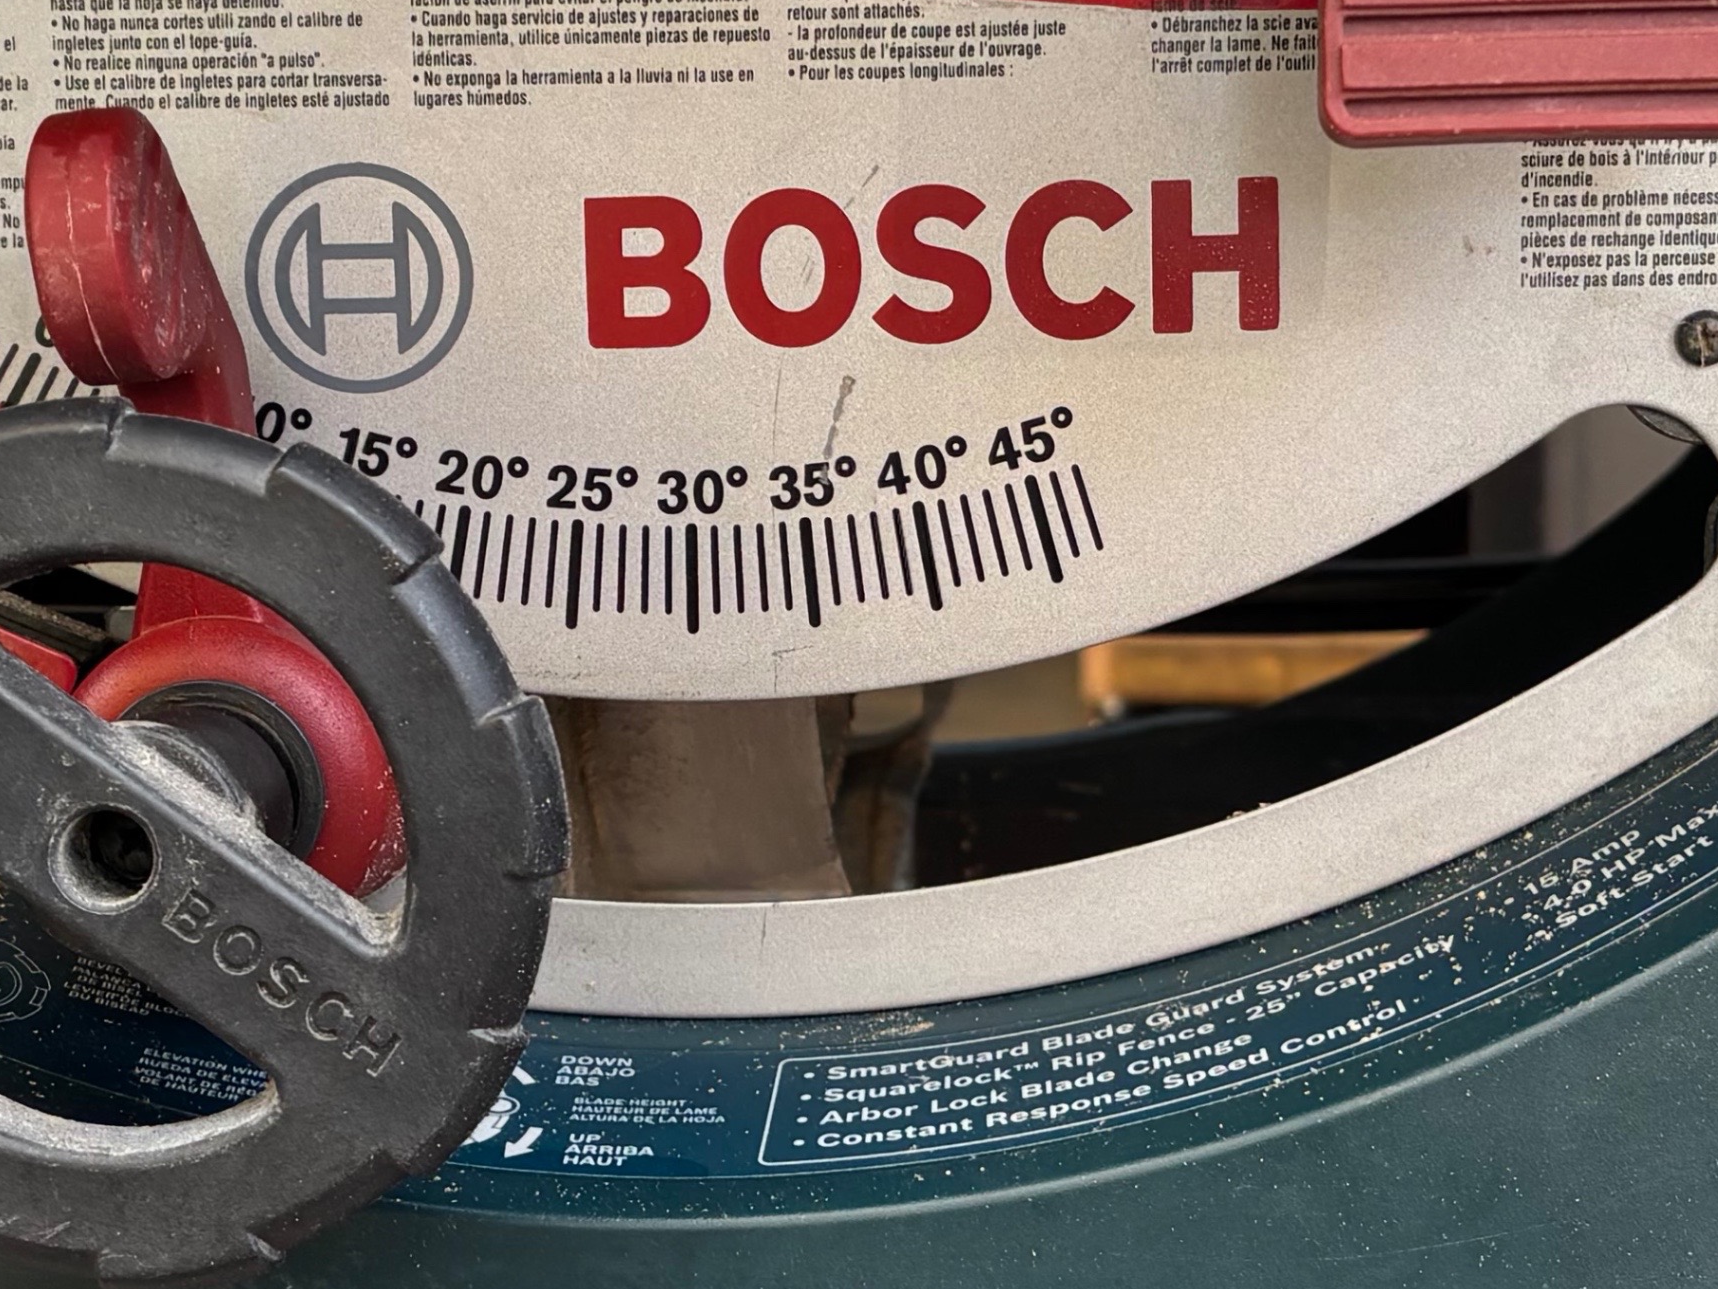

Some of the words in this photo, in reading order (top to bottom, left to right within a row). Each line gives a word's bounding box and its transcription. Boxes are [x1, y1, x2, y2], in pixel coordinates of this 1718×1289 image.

[414, 91, 463, 109] lugares
[583, 176, 1281, 350] BOSCH
[1583, 272, 1607, 289] pas
[1612, 270, 1645, 287] dans
[1649, 269, 1673, 286] des
[254, 401, 312, 445] 0°
[339, 426, 418, 477] 15°
[435, 449, 529, 500] 20°
[546, 464, 638, 512] 25°
[657, 464, 748, 514] 30°
[769, 455, 856, 510] 35°
[877, 435, 967, 495] 40°
[988, 406, 1073, 471] 45°
[1570, 829, 1640, 877] Amp
[1600, 847, 1646, 880] HP
[1555, 887, 1626, 929] Soft
[1631, 835, 1714, 888] Start
[163, 889, 402, 1078] BOSCH
[1051, 1050, 1106, 1072] Rip
[1118, 1022, 1215, 1056] Fence
[1314, 934, 1455, 998] Capacity
[827, 1042, 1029, 1080] SmartGuard
[1042, 1022, 1136, 1053] Blade
[1145, 988, 1245, 1028] Guard
[561, 1055, 632, 1067] DOWN
[555, 1075, 599, 1086] BAS
[557, 1066, 635, 1077] ABAJO
[817, 1117, 973, 1148] Constant
[985, 1083, 1152, 1128] Response
[1163, 1048, 1270, 1090] Speed
[1280, 999, 1407, 1055] Control
[819, 1102, 919, 1126] Arbor
[931, 1089, 1009, 1113] Lock
[1021, 1068, 1116, 1099] Blade
[1127, 1032, 1253, 1076] Change
[572, 1105, 644, 1115] HAUTEUR
[649, 1107, 670, 1115] DE
[675, 1106, 718, 1115] LAME
[574, 1097, 624, 1106] BLADE
[629, 1098, 687, 1107] HEIGHT
[569, 1114, 628, 1123] ALTURA
[633, 1115, 654, 1123] DE
[659, 1115, 677, 1123] LA
[683, 1115, 726, 1124] HOJA
[569, 1133, 601, 1143] UP
[563, 1155, 627, 1166] HAUT
[564, 1145, 654, 1156] ARRIBA
